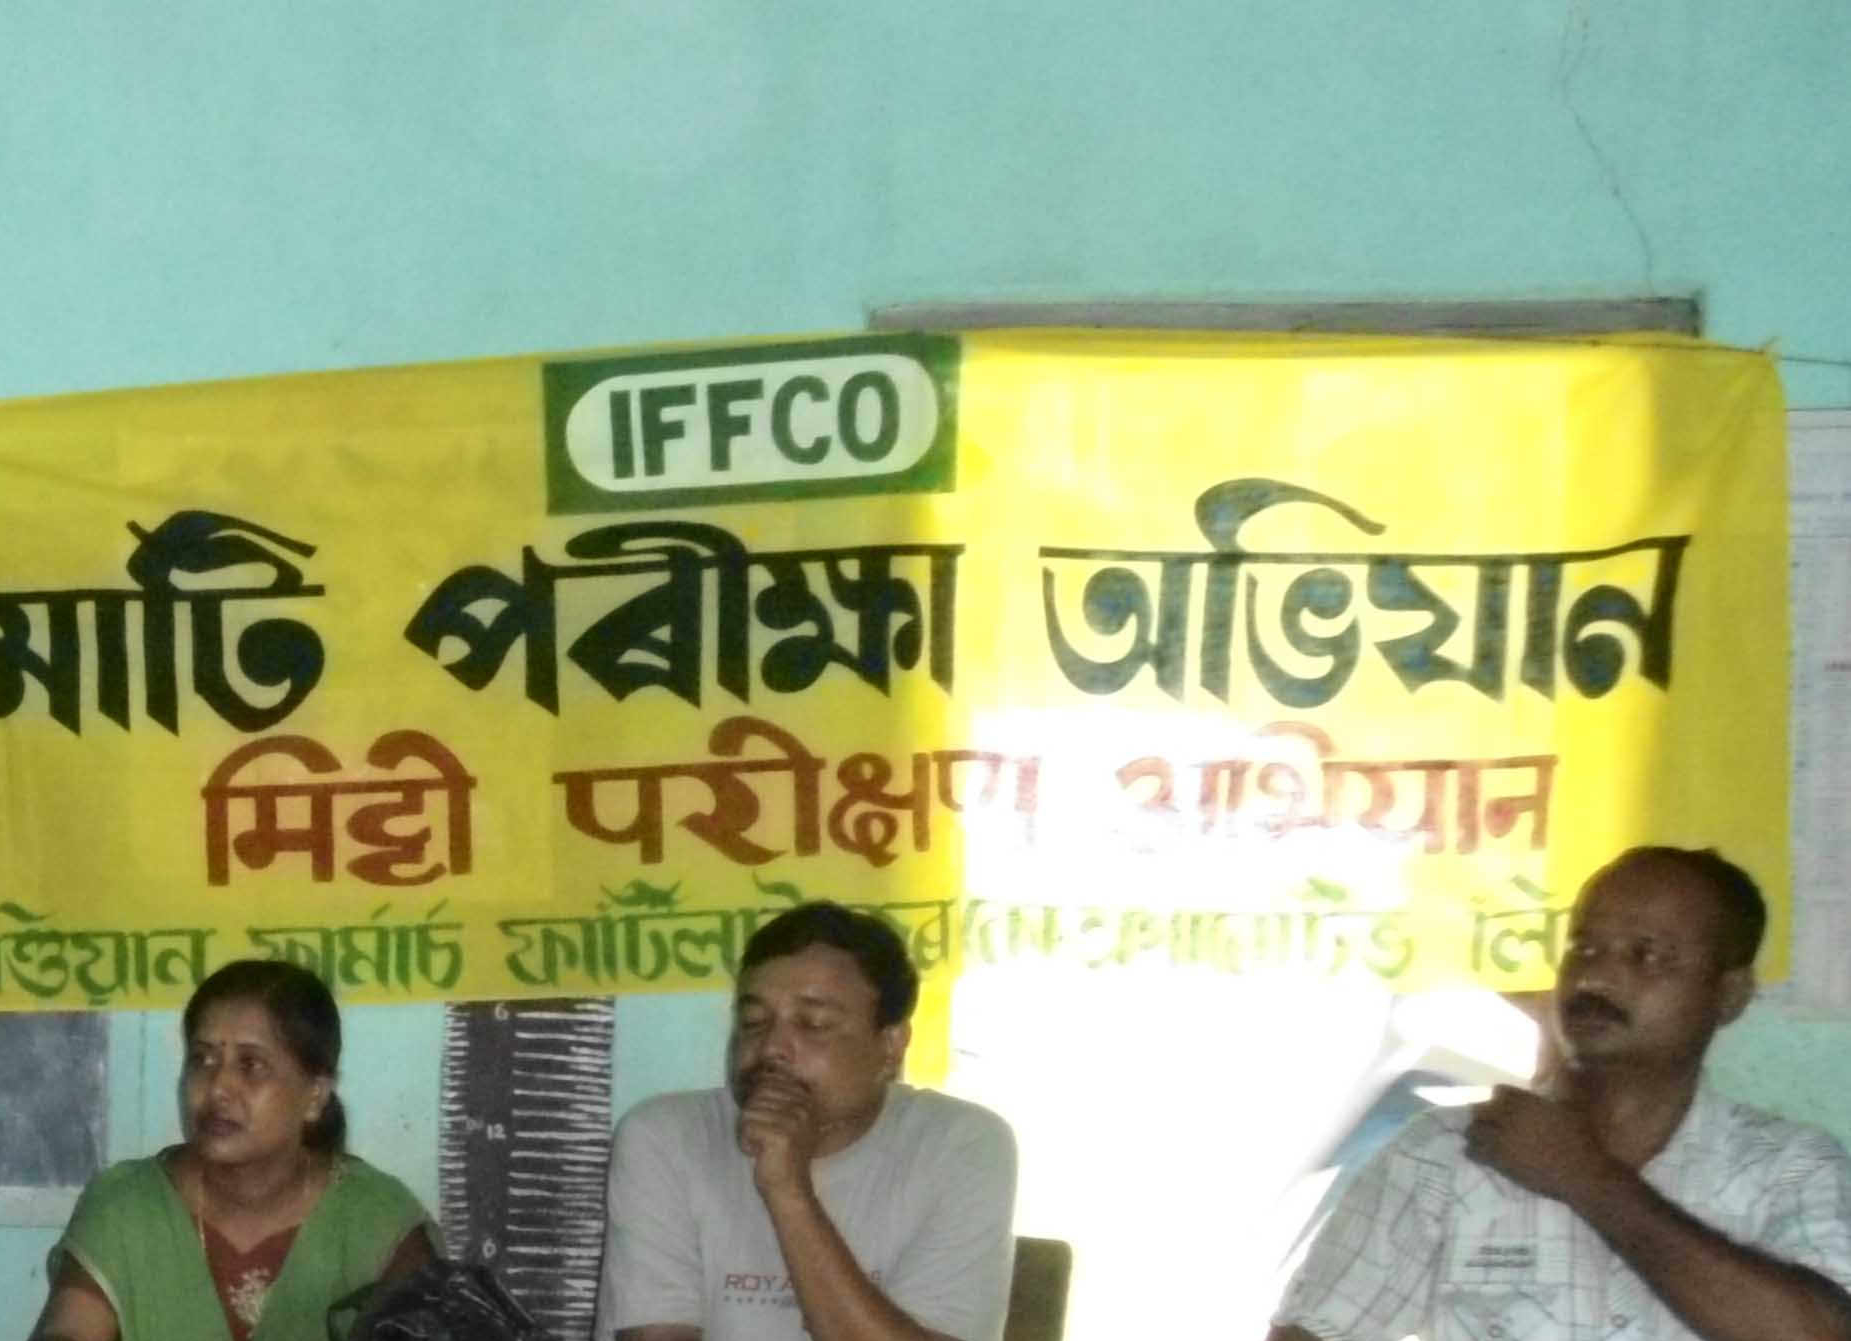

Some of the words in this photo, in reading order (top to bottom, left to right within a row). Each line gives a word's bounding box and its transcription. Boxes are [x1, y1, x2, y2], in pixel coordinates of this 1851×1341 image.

[608, 369, 901, 480] IFFCO
[403, 520, 965, 717] পৰীক্ষা
[1038, 476, 1694, 709] অভিযান
[552, 715, 1043, 868] परीक्षण
